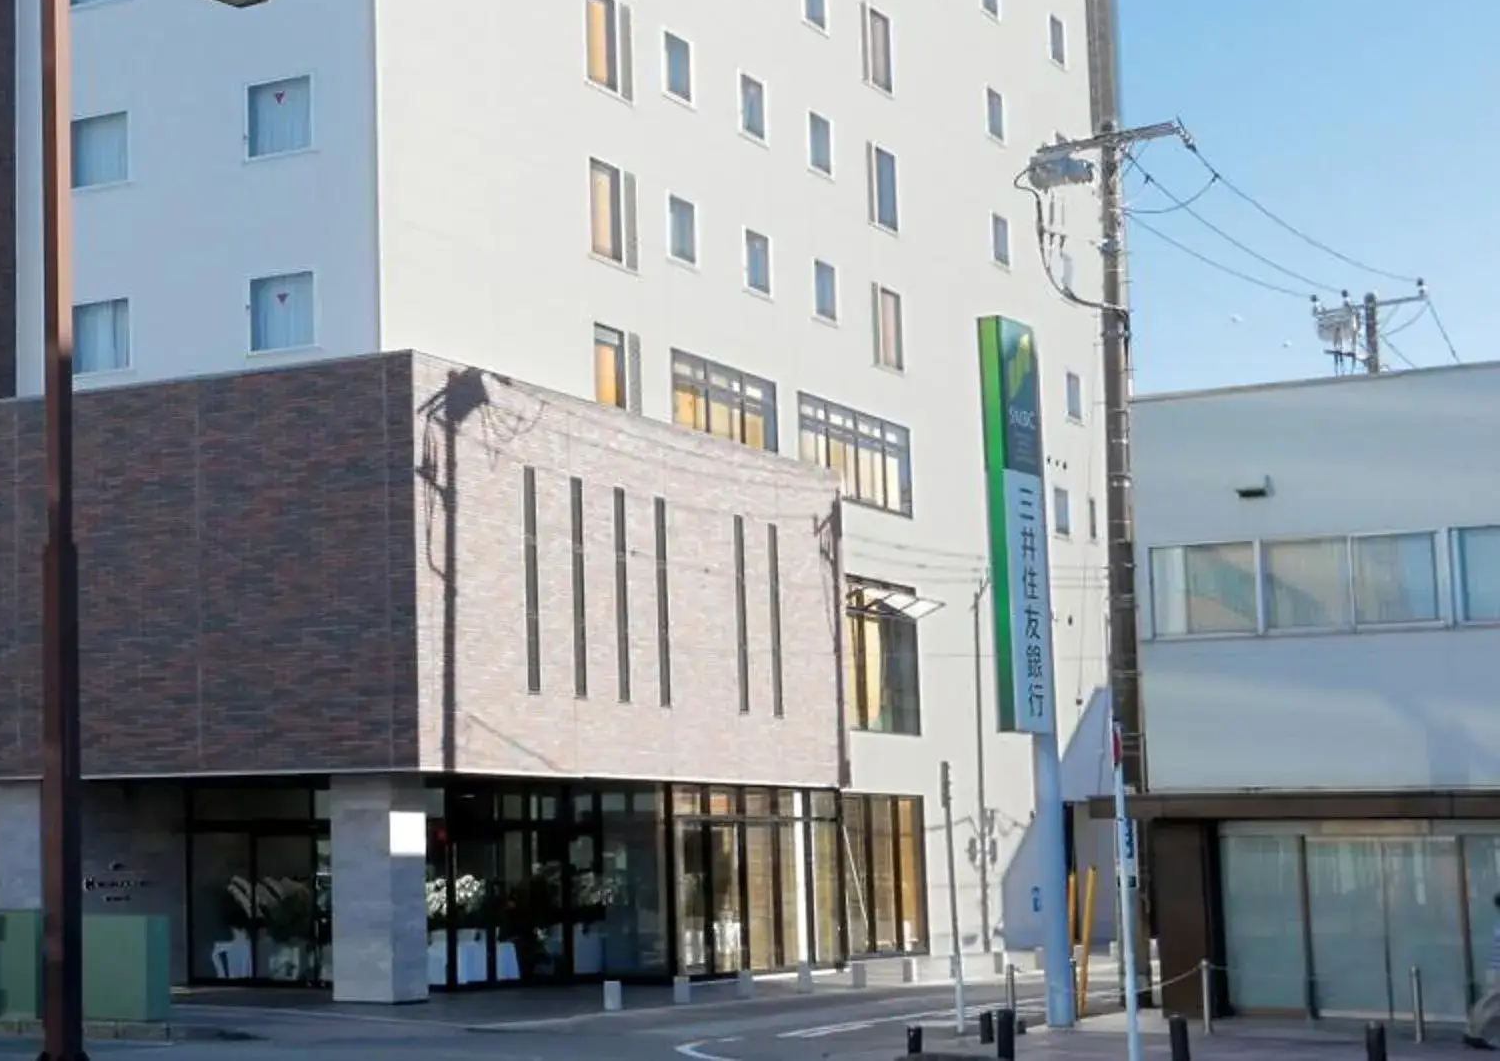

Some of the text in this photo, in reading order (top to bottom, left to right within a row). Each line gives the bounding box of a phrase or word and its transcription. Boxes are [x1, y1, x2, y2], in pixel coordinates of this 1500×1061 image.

[1018, 487, 1045, 718] 三井住友銀行
